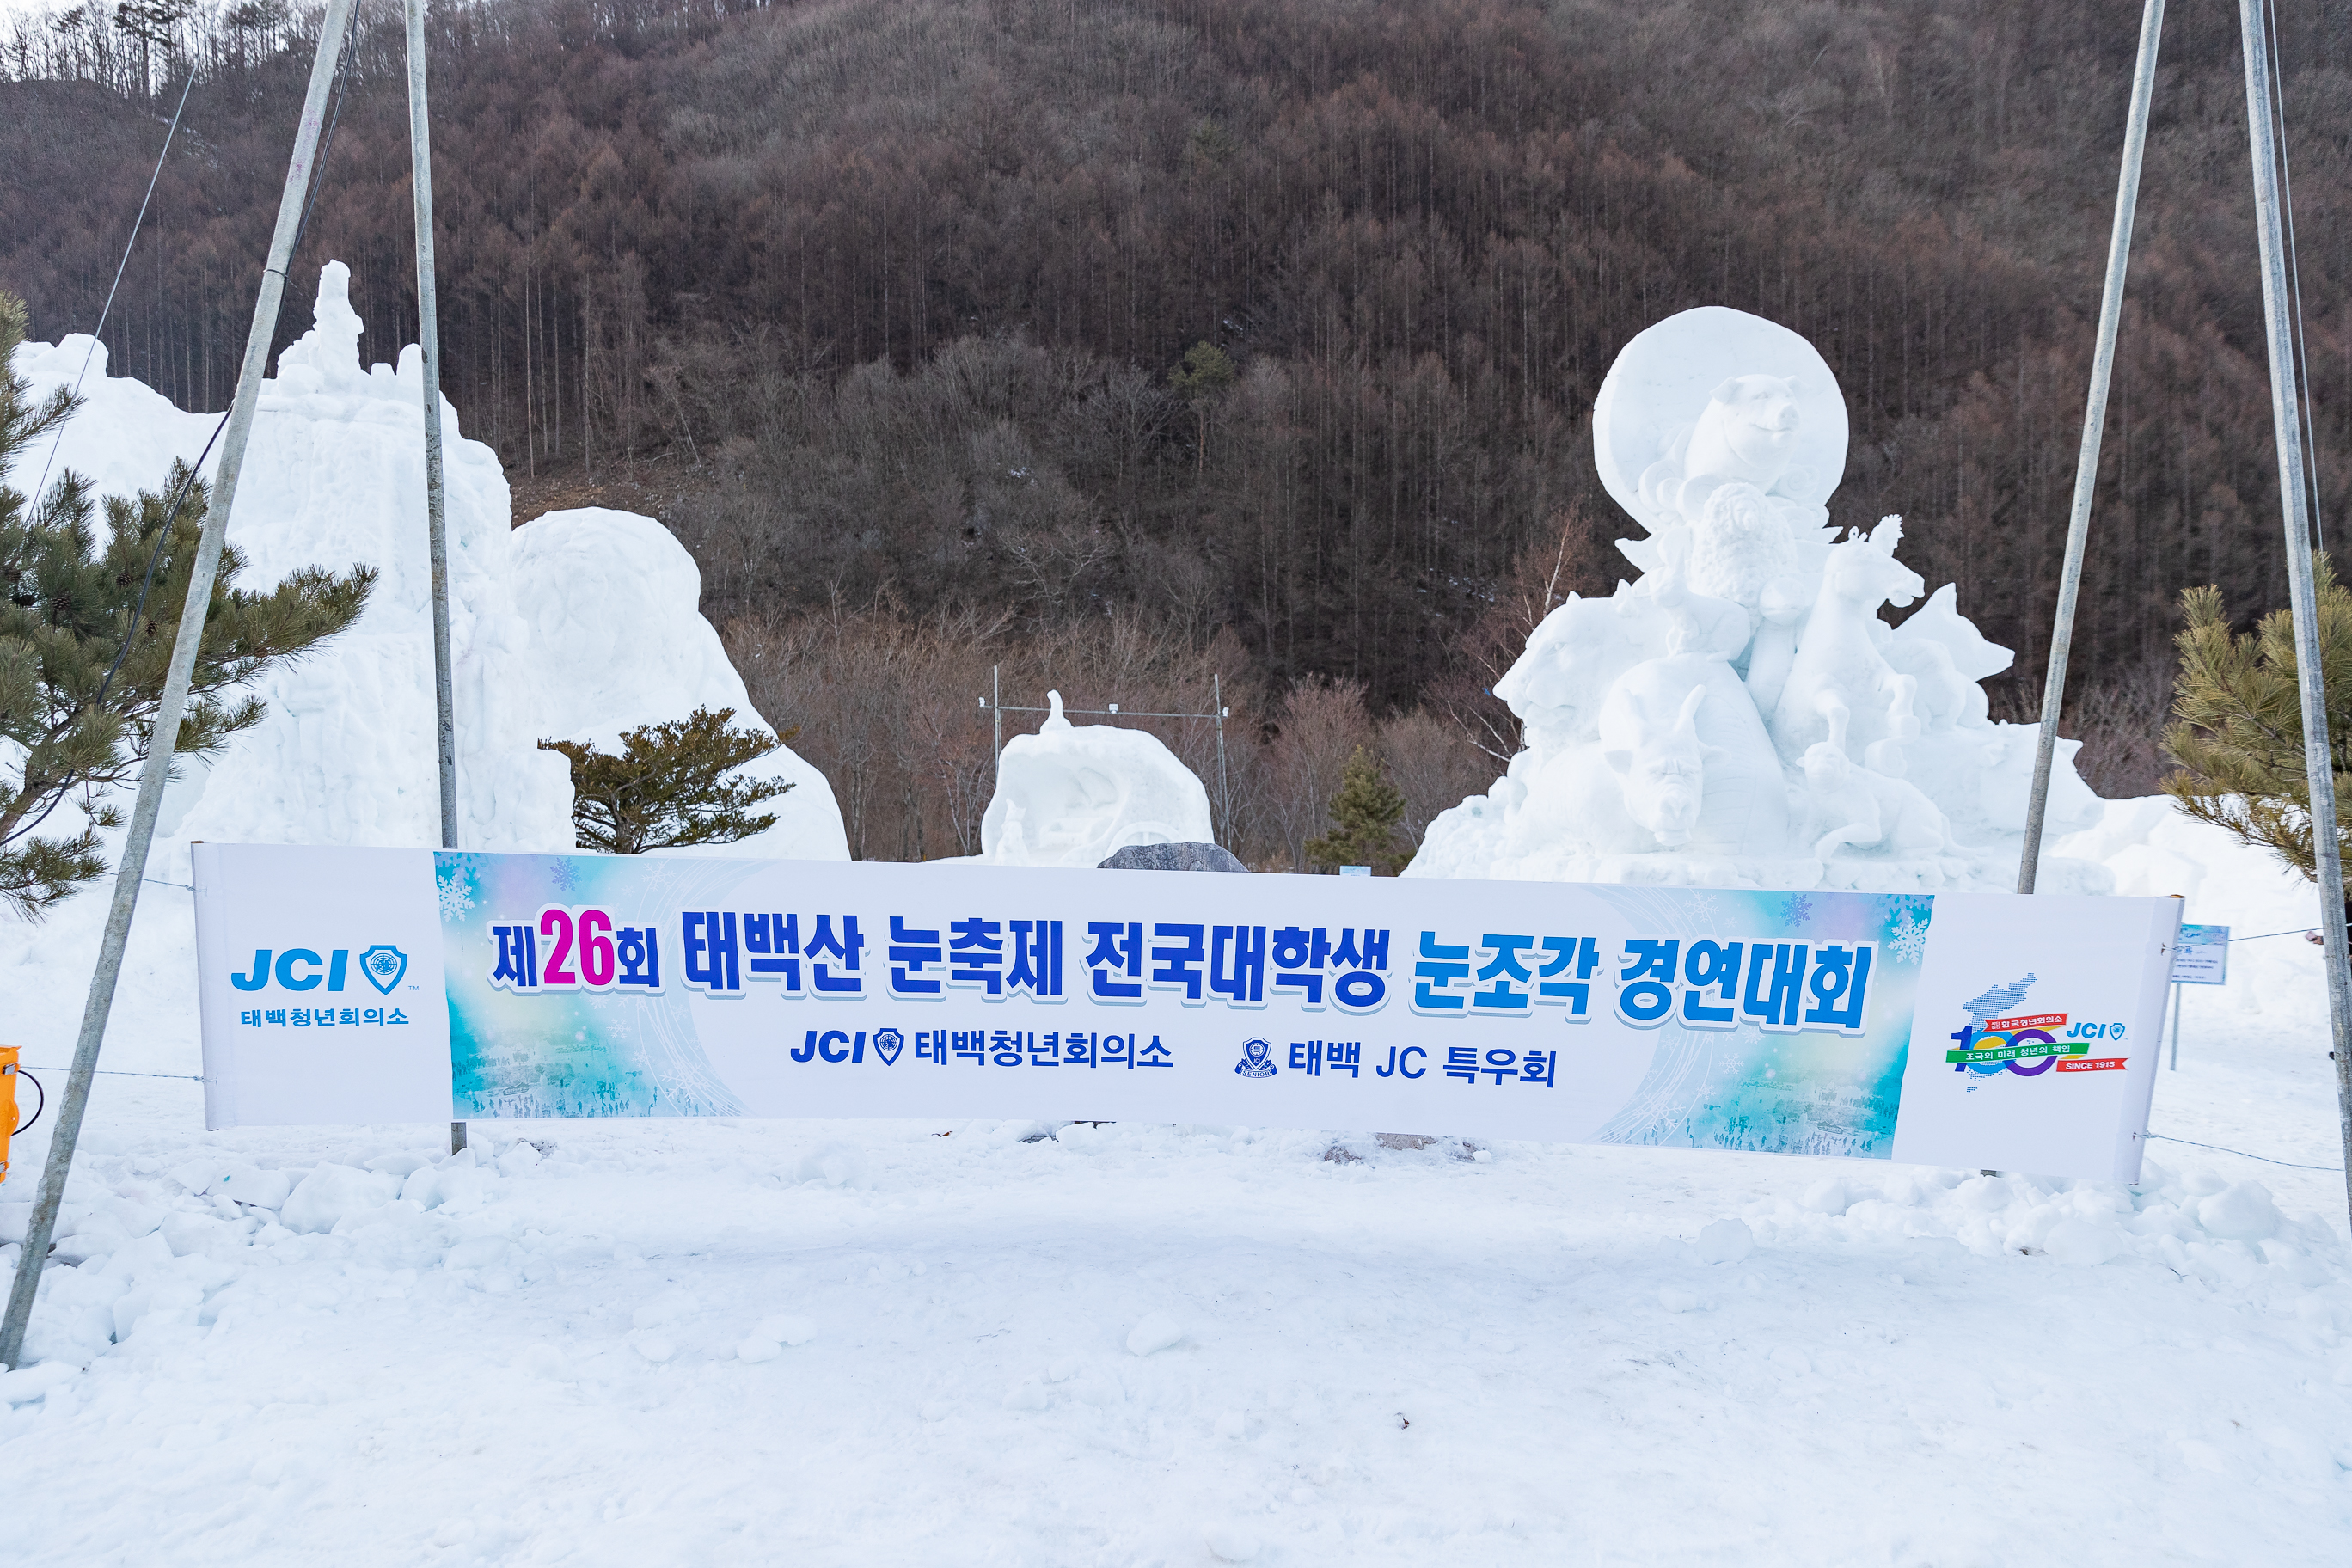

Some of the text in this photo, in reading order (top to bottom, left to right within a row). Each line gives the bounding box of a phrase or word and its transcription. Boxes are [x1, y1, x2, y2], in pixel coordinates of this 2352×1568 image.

[230, 948, 349, 992] JCI
[493, 909, 1873, 1029] 제26회 태백산 눈축제 전국대학생 눈조각 경연대회
[241, 1008, 409, 1028] 태백청년회의소
[2001, 1016, 2063, 1028] 한국청년회의소
[2067, 1022, 2107, 1039] JCI
[790, 1030, 1174, 1069] JCI 태백청년회의소
[1289, 1040, 1557, 1088] 태백 JC 특우회
[1965, 1052, 1994, 1061] 조국의
[1997, 1050, 2016, 1058] 미래
[2020, 1046, 2048, 1057] 청년의
